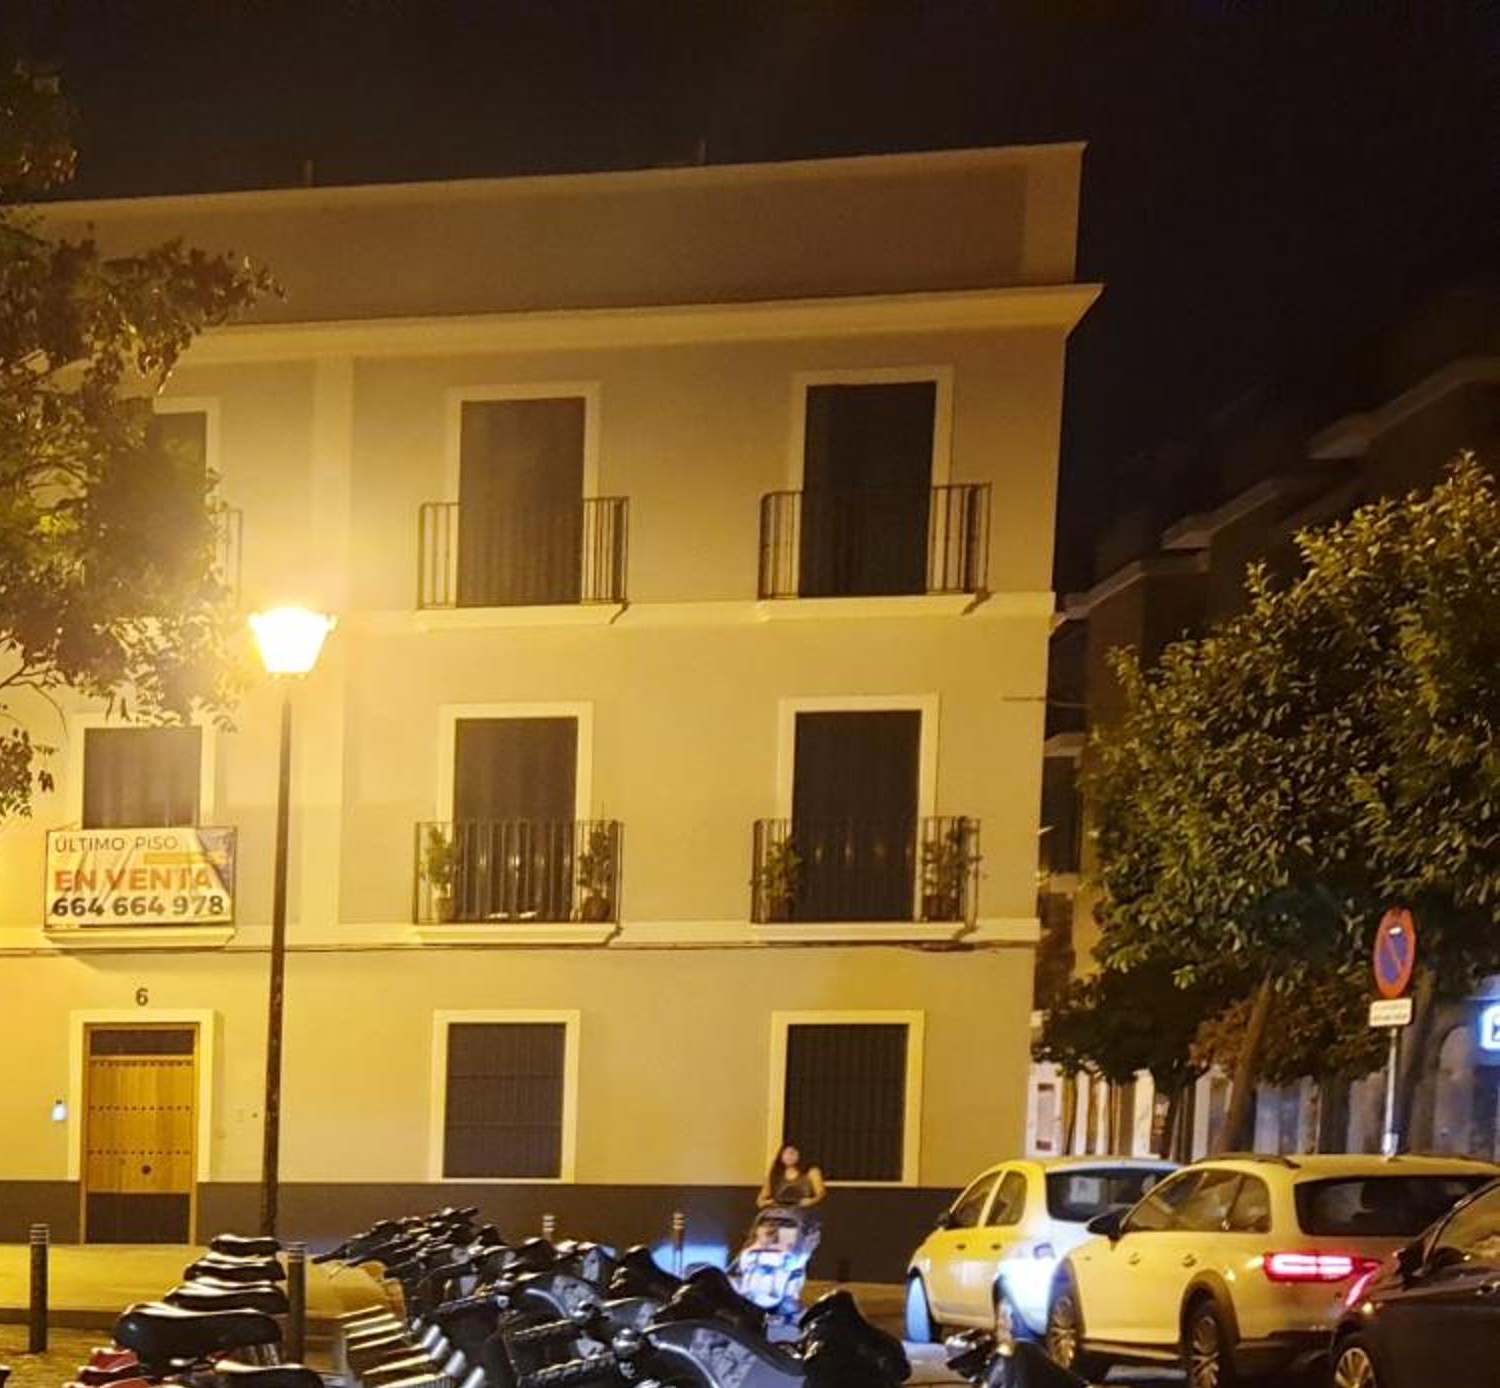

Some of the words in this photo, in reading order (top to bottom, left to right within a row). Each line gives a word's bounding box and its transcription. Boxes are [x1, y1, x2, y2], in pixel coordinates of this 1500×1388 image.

[134, 834, 179, 851] PISO
[55, 868, 97, 892] EN
[106, 867, 213, 892] VENTA
[52, 897, 104, 917] 664
[112, 896, 165, 916] 664
[172, 895, 225, 916] 978
[136, 987, 149, 1007] 6
